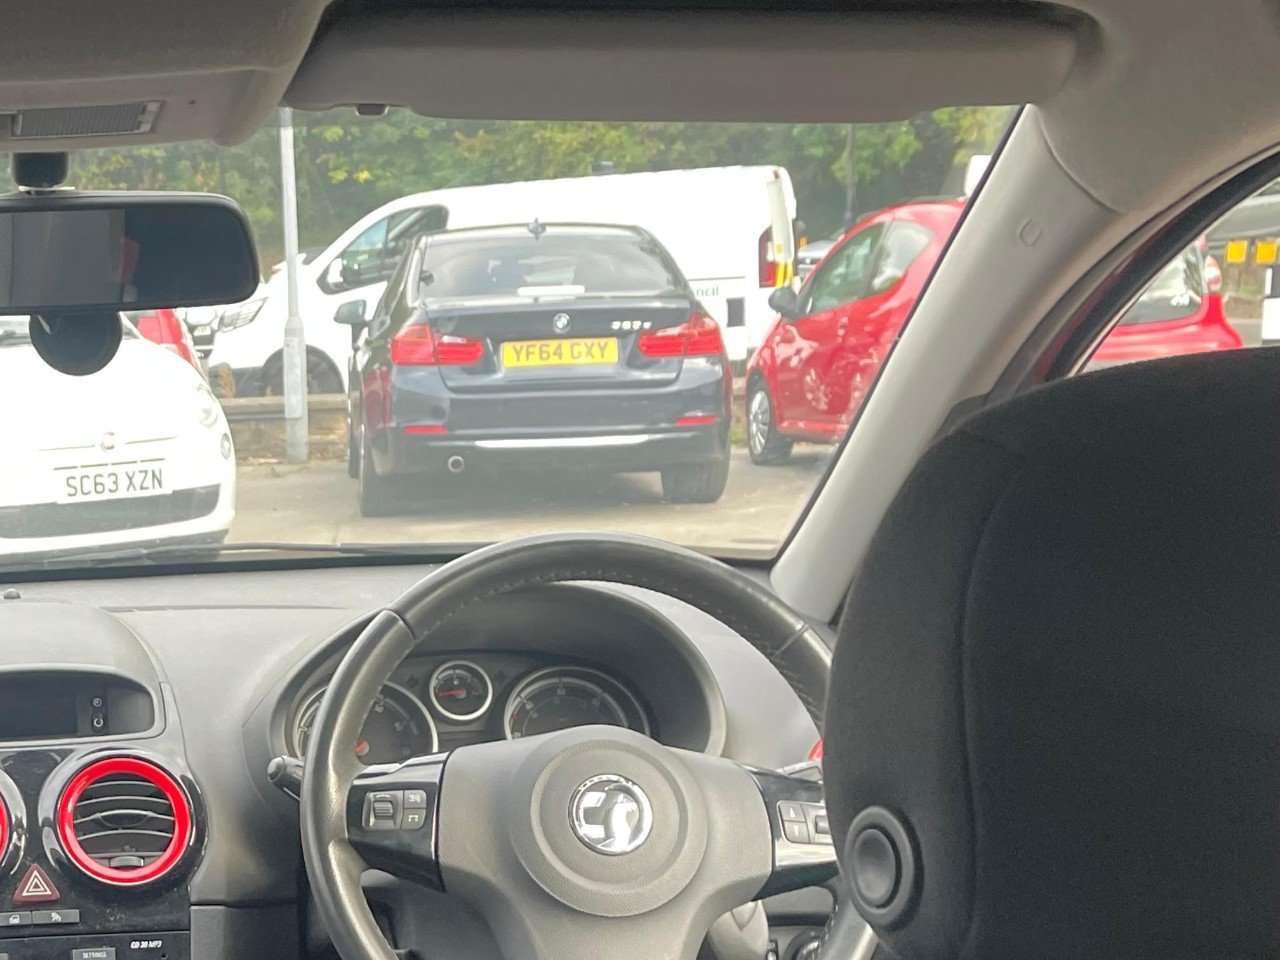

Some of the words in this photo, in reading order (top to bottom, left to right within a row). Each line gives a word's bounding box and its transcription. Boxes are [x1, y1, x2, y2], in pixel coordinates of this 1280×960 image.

[511, 343, 563, 363] YF64
[570, 341, 609, 360] GXY
[65, 472, 119, 497] SC63
[125, 468, 163, 492] XZN
